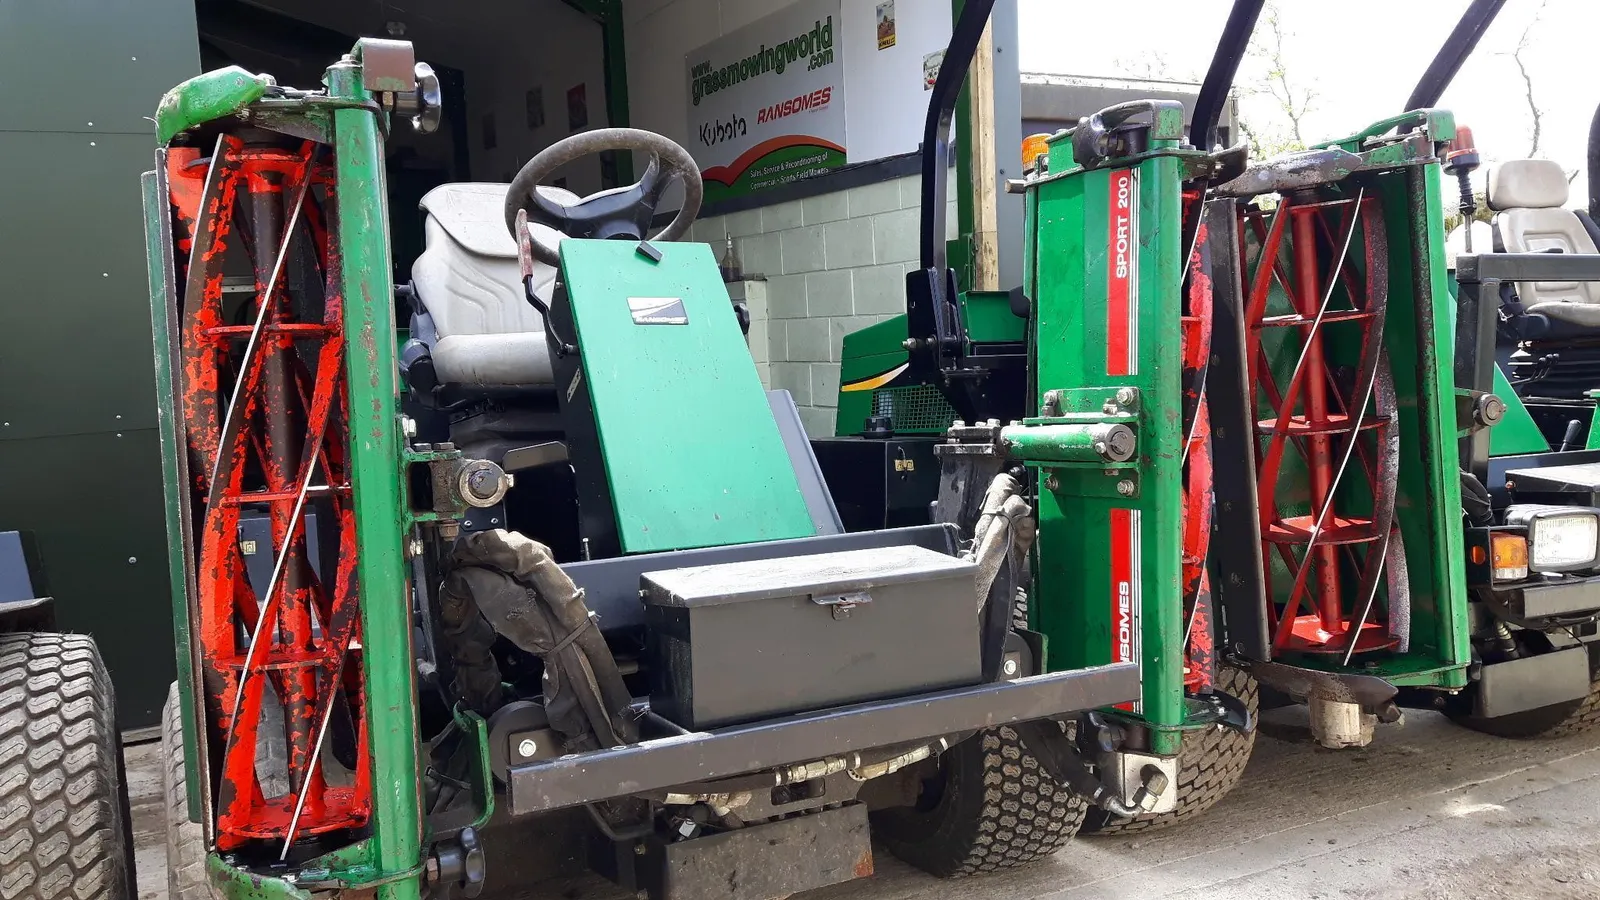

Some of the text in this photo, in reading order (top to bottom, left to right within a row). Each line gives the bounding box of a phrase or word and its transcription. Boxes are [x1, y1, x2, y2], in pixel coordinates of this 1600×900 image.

[691, 15, 833, 106] grassmowingworld
[691, 60, 713, 79] www.
[807, 48, 834, 71] .com
[757, 86, 832, 124] RANSOMES
[700, 114, 747, 146] Kubota
[763, 167, 780, 175] Service
[785, 154, 821, 170] Reconditioning
[822, 152, 828, 161] of
[781, 174, 796, 182] Sports
[796, 170, 808, 179] Field
[1116, 176, 1128, 278] SPORT 200
